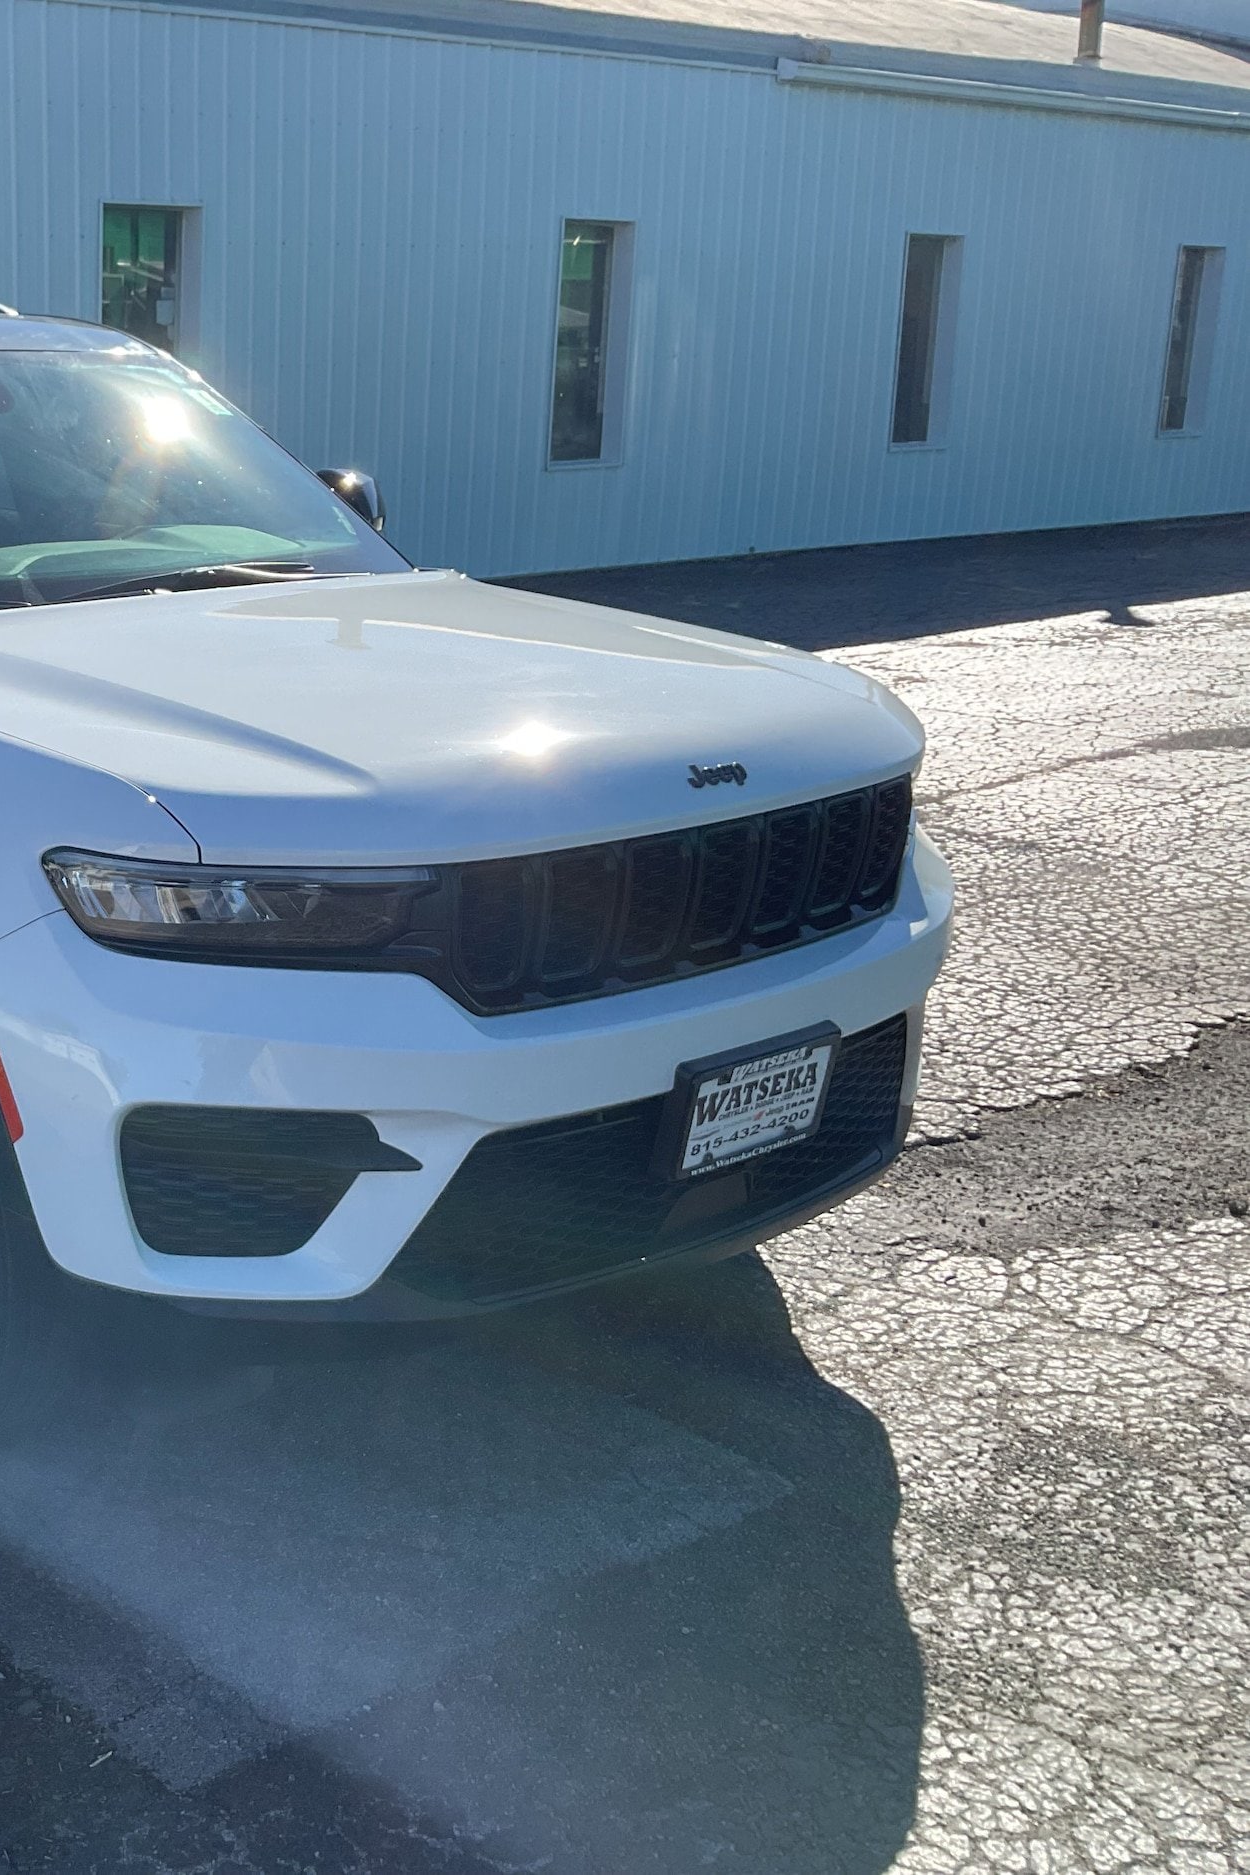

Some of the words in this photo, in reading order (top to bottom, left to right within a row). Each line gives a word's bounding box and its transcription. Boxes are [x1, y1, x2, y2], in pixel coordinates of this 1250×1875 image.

[687, 762, 747, 789] Jeep
[730, 1046, 808, 1083] WATSEKA
[696, 1062, 818, 1126] WATSEKA
[690, 1109, 809, 1156] 815-432-4200
